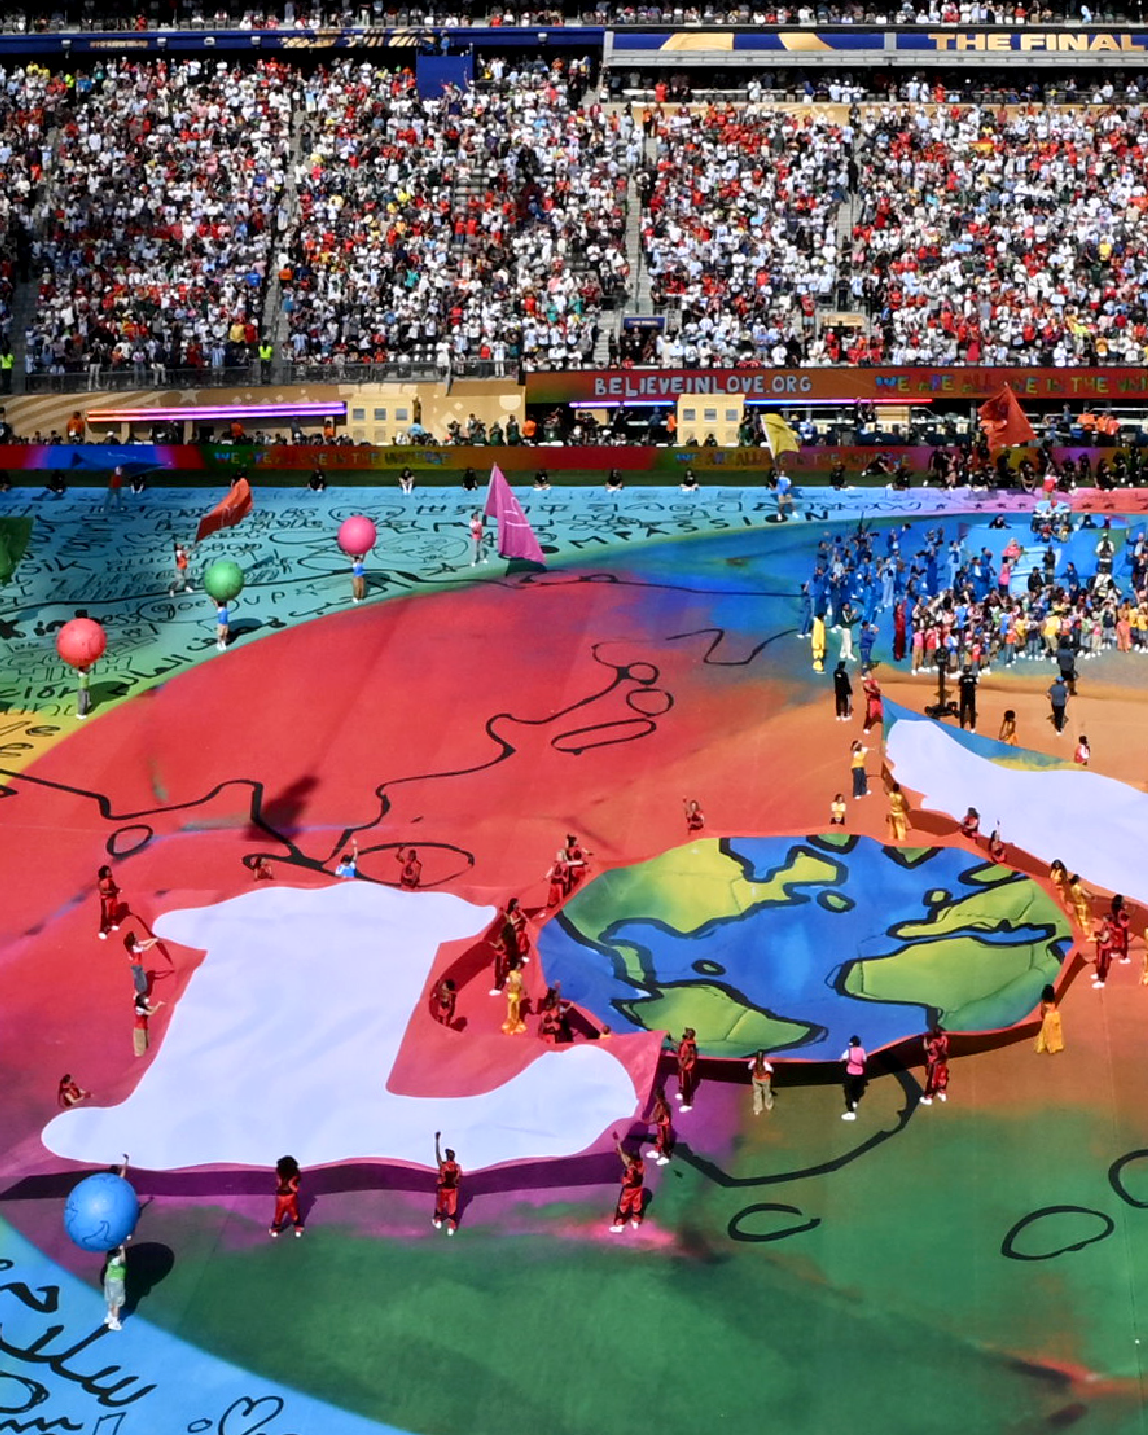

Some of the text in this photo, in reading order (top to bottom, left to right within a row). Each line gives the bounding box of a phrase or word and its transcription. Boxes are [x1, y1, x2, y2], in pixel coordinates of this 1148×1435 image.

[928, 33, 1146, 52] THE FINAL
[594, 375, 812, 397] BELIEVEINLOVE.ORG
[875, 375, 910, 392] WE
[918, 375, 954, 392] ARE
[962, 375, 996, 393] ALL
[1070, 376, 1109, 394] THE
